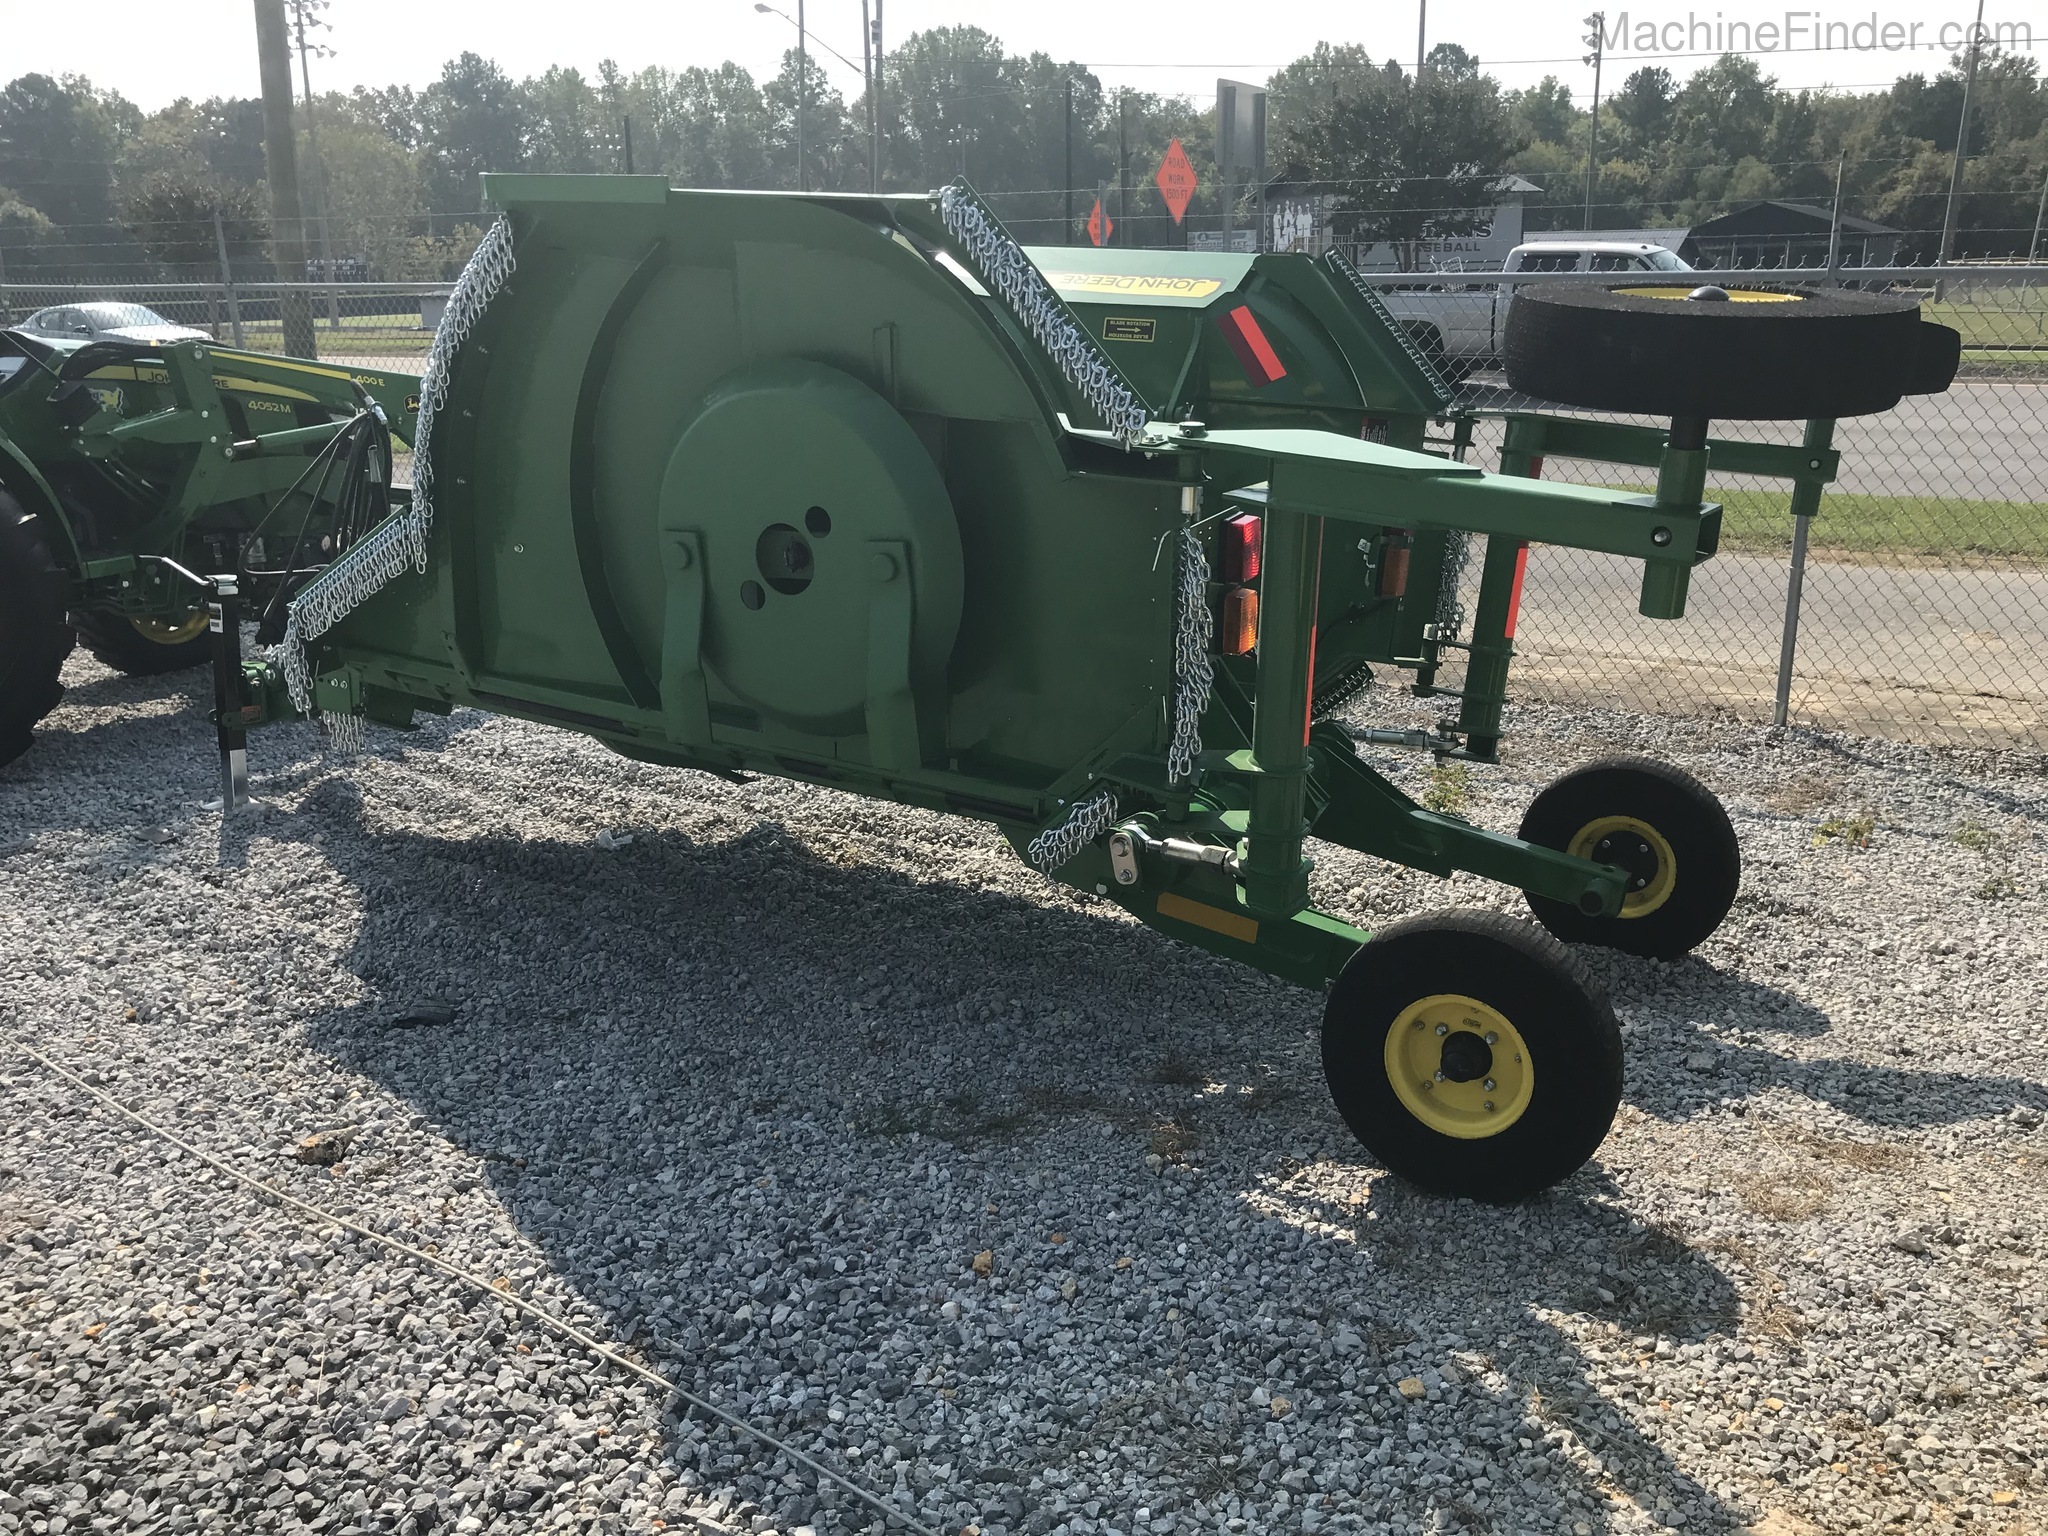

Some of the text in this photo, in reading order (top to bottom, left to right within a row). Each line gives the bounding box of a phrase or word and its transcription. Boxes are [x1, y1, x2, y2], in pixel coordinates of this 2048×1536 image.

[1168, 157, 1185, 169] ROAD
[1168, 174, 1185, 185] WORK
[1166, 188, 1188, 201] 1500 FT
[1060, 273, 1207, 292] JOHN DEERE
[248, 400, 291, 413] 4052M
